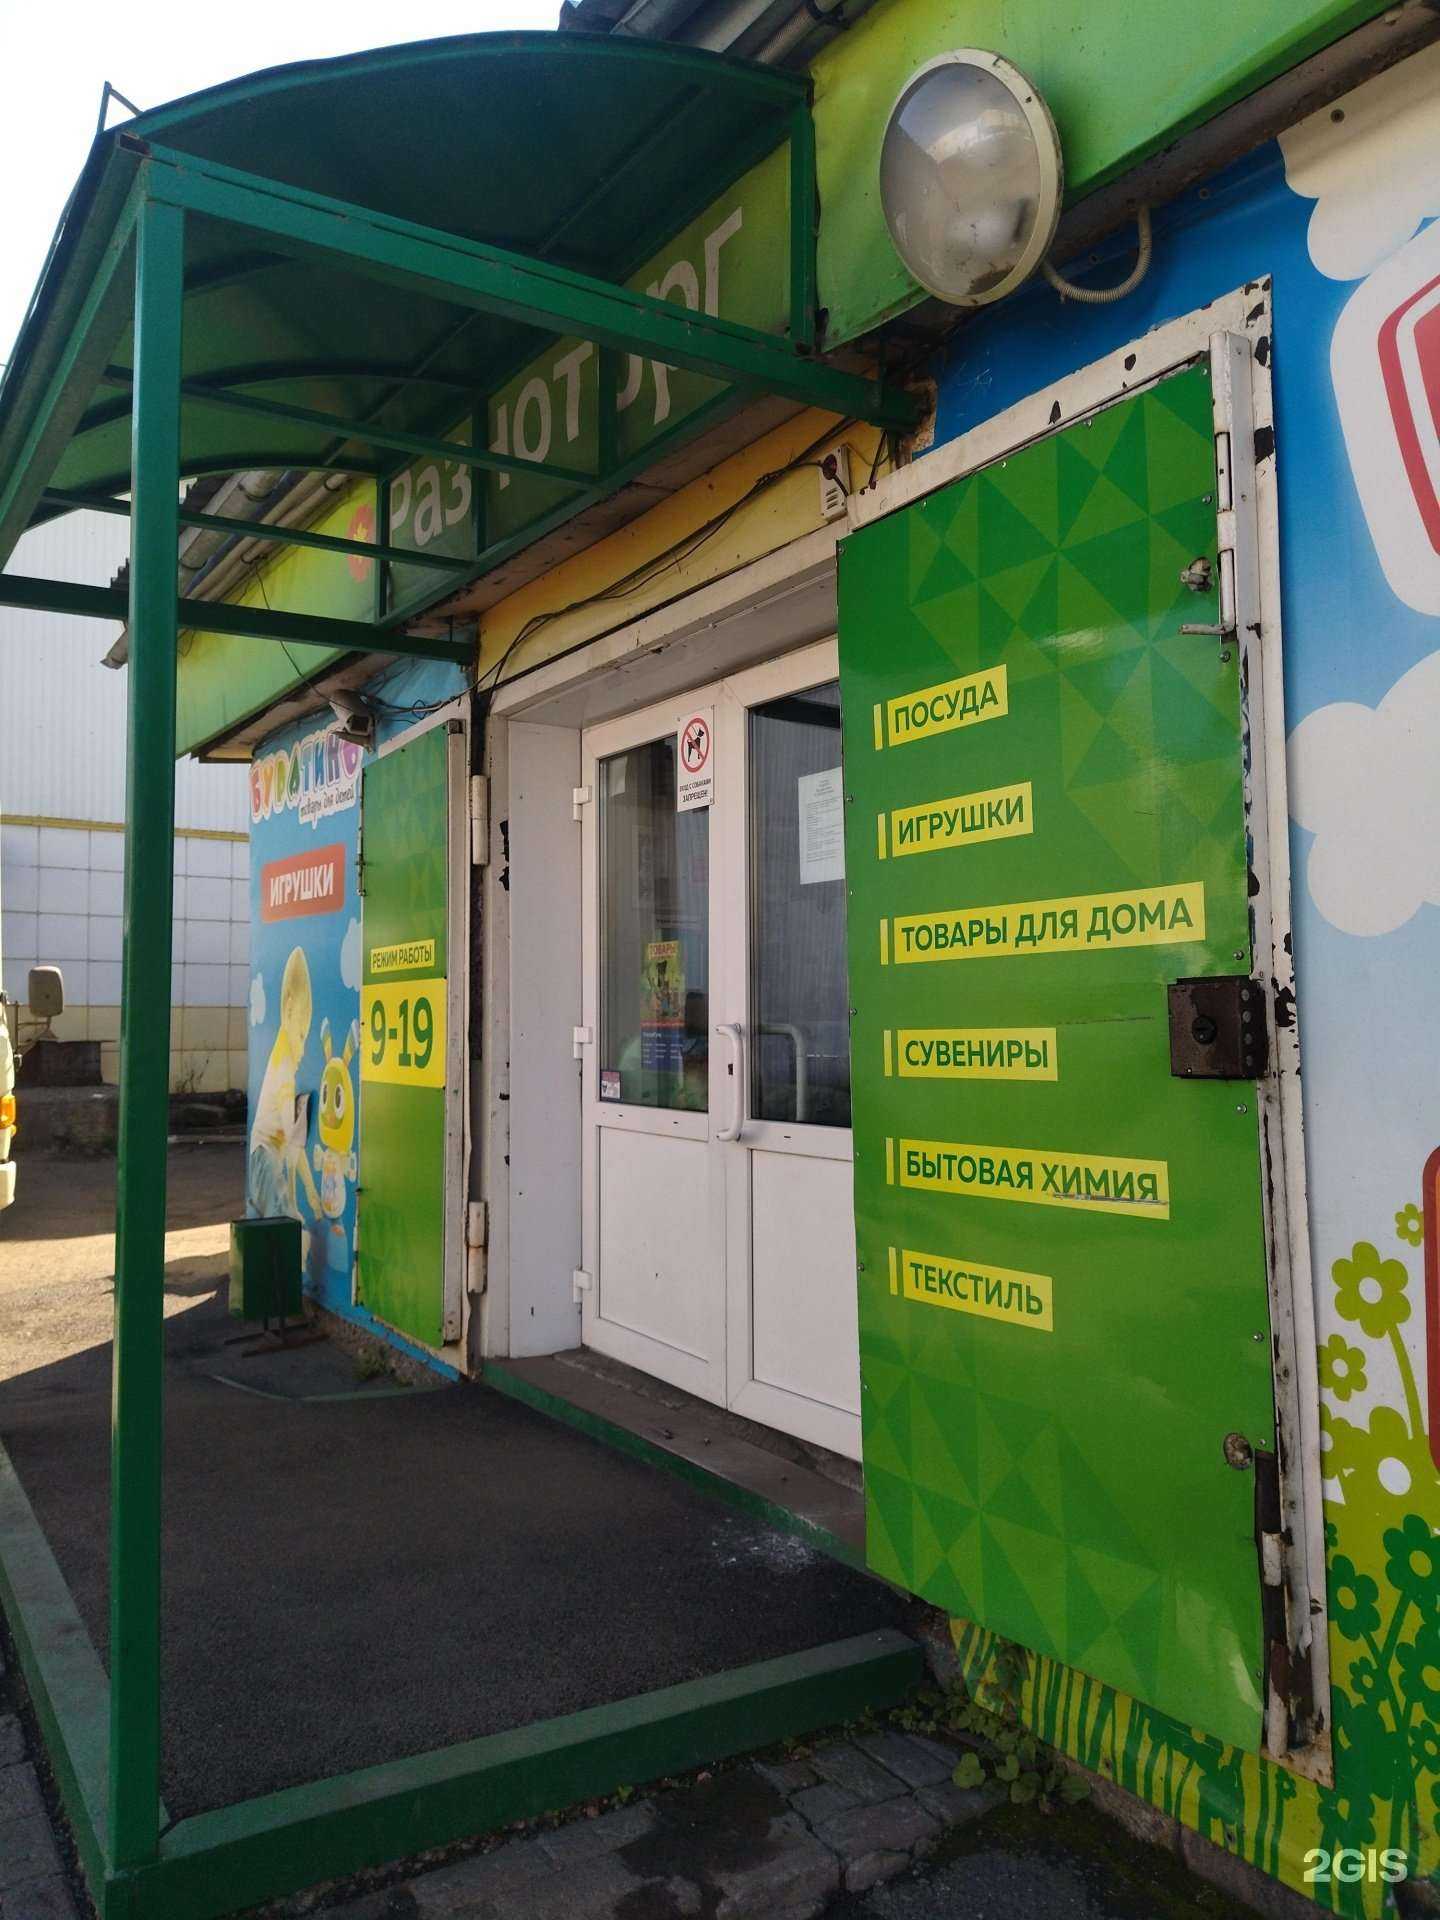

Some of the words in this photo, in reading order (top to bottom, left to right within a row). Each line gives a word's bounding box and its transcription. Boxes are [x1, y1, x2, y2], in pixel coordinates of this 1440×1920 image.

[894, 680, 999, 734] ПОСУДА
[897, 794, 1024, 845] ИГРУШКИ
[269, 862, 335, 908] ИГРУШКИ
[900, 917, 1008, 953] ТОВАРЫ
[1014, 908, 1079, 948] ДЛЯ
[1085, 896, 1195, 942] ДОМА
[372, 951, 398, 969] РЕЖИМ
[399, 945, 432, 966] РАБОТЫ
[371, 997, 433, 1069] 9-19
[904, 1039, 1049, 1069] СУВЕНИРЫ
[906, 1150, 1034, 1191] БЫТОВАЯ
[1040, 1162, 1159, 1201] ХИМИЯ
[909, 1262, 1044, 1316] ТЕКСТИЛЬ
